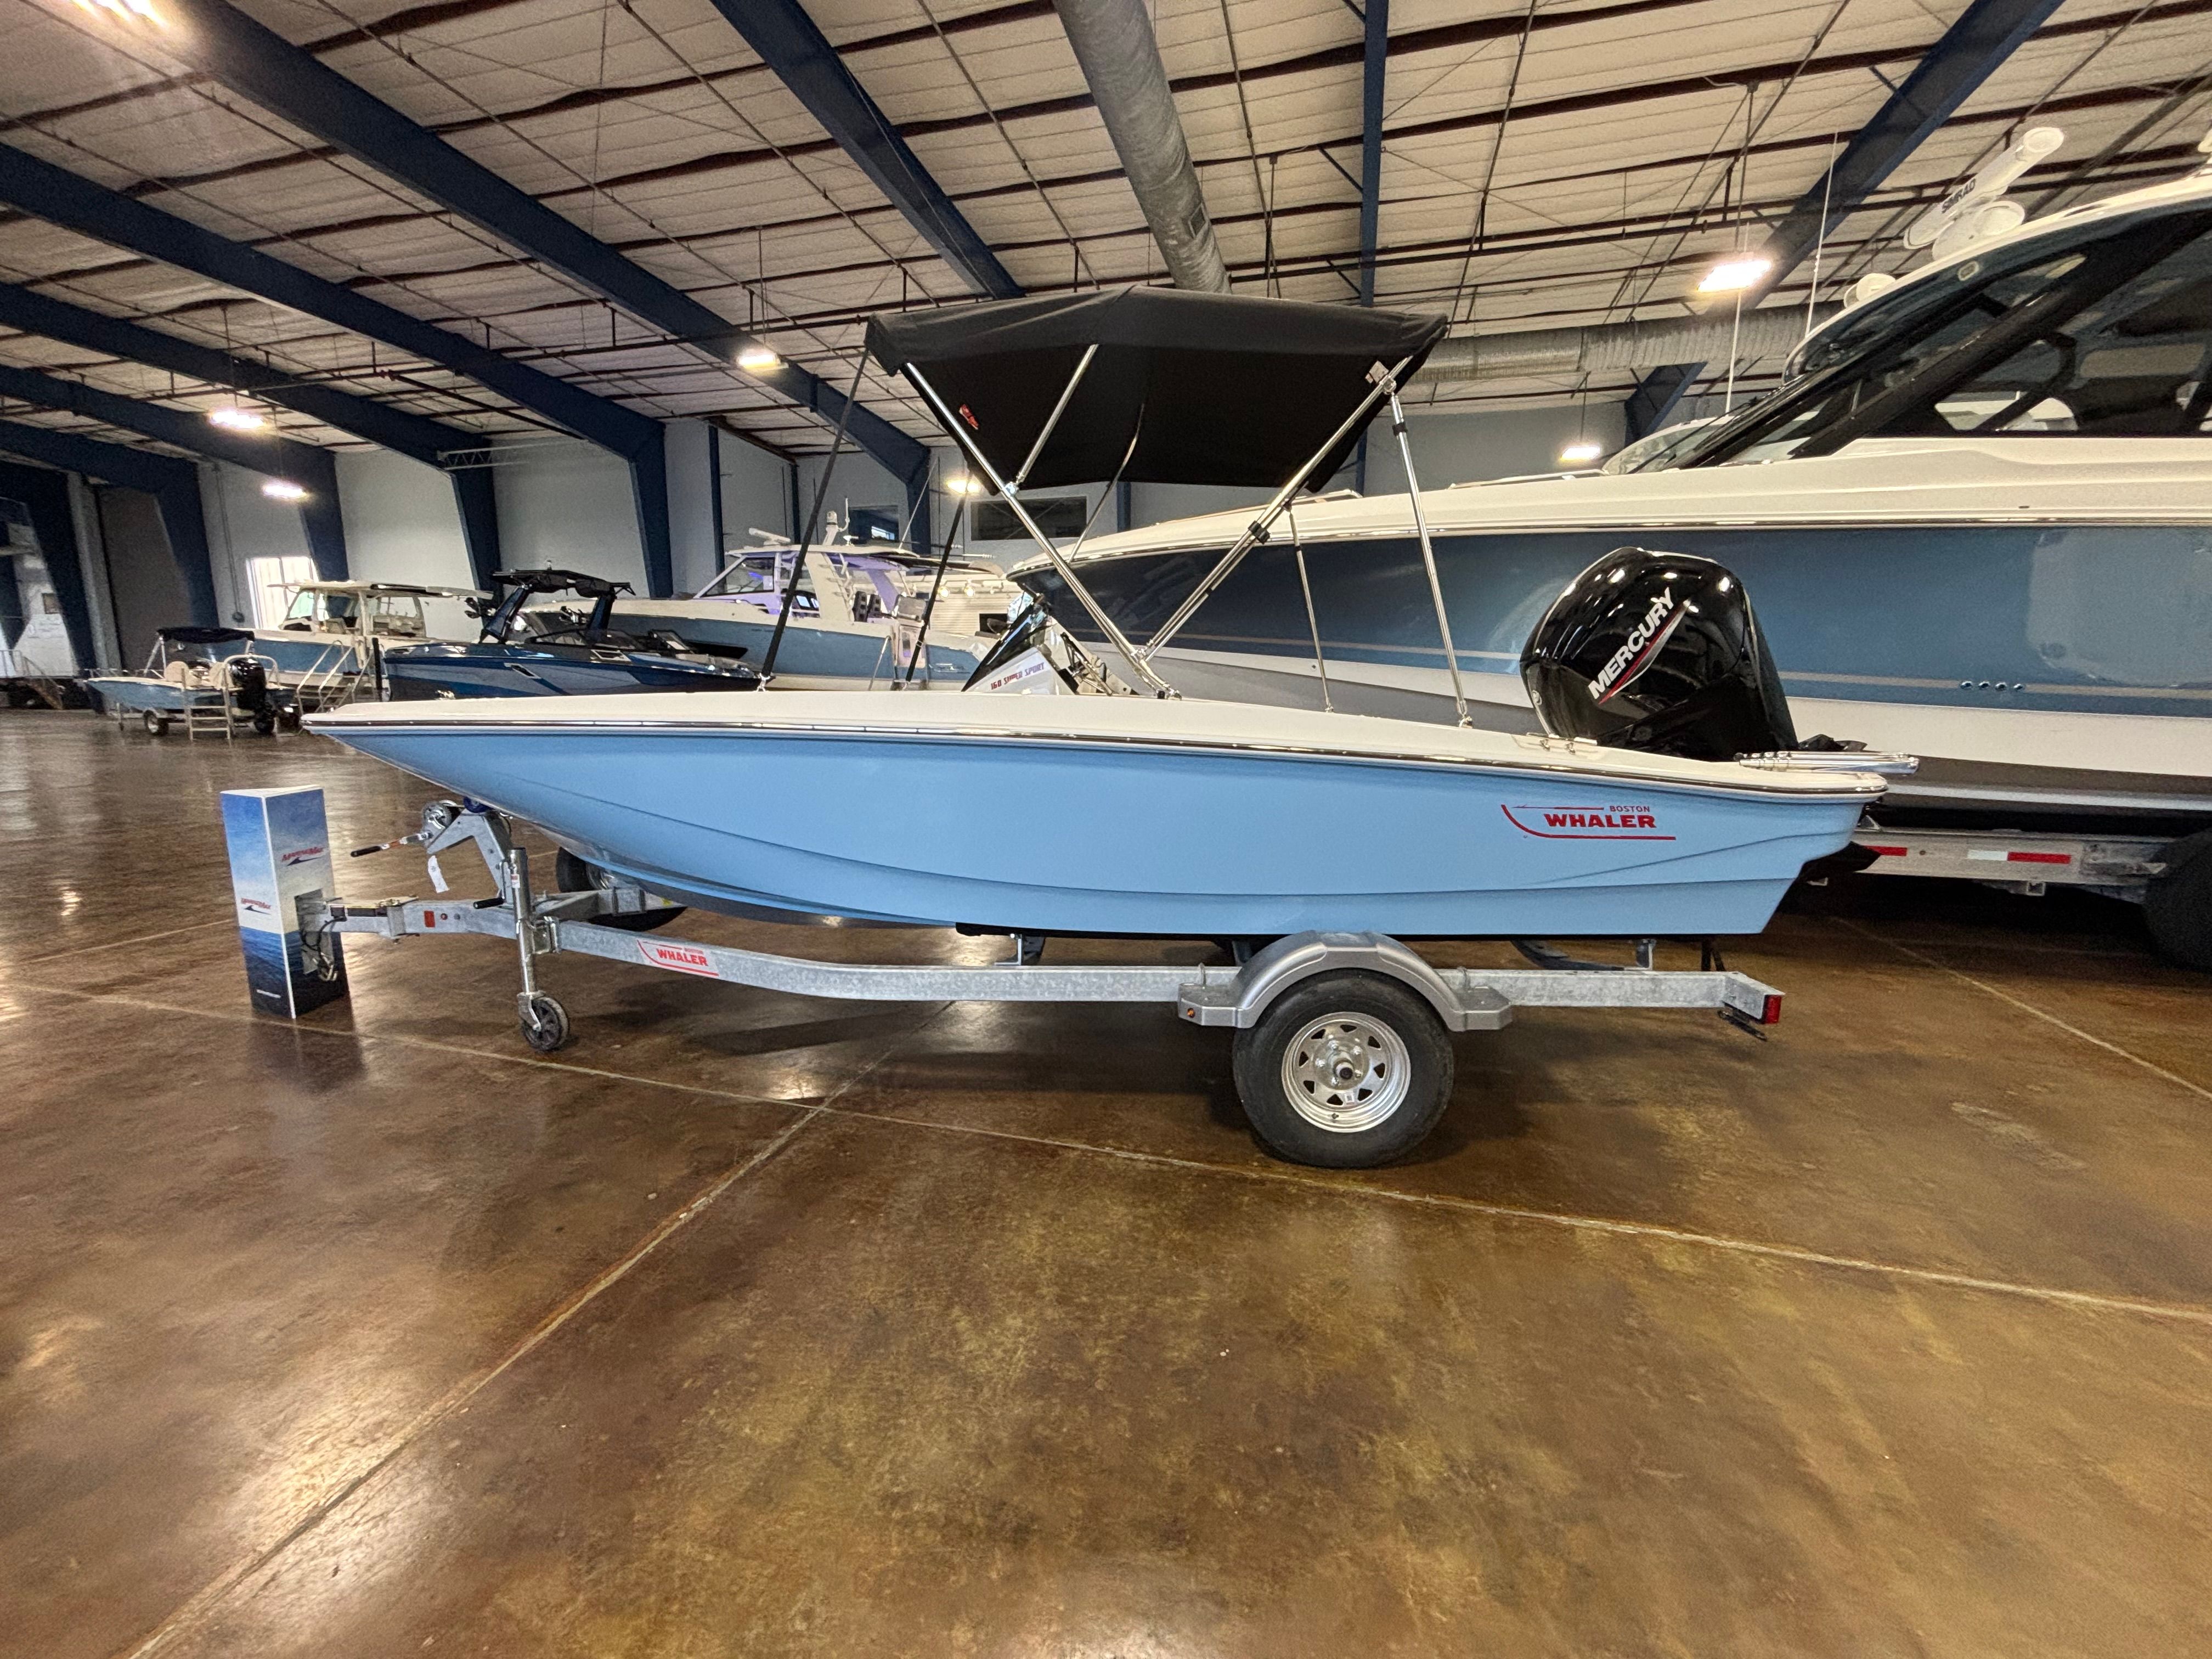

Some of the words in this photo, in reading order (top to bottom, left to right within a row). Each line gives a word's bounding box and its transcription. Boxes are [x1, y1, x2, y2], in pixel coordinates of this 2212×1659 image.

[1588, 586, 1674, 699] MERCURY
[991, 680, 1001, 690] 160
[1024, 662, 1045, 676] SPORT
[1543, 814, 1657, 828] WHALER
[656, 948, 708, 966] WHALER
